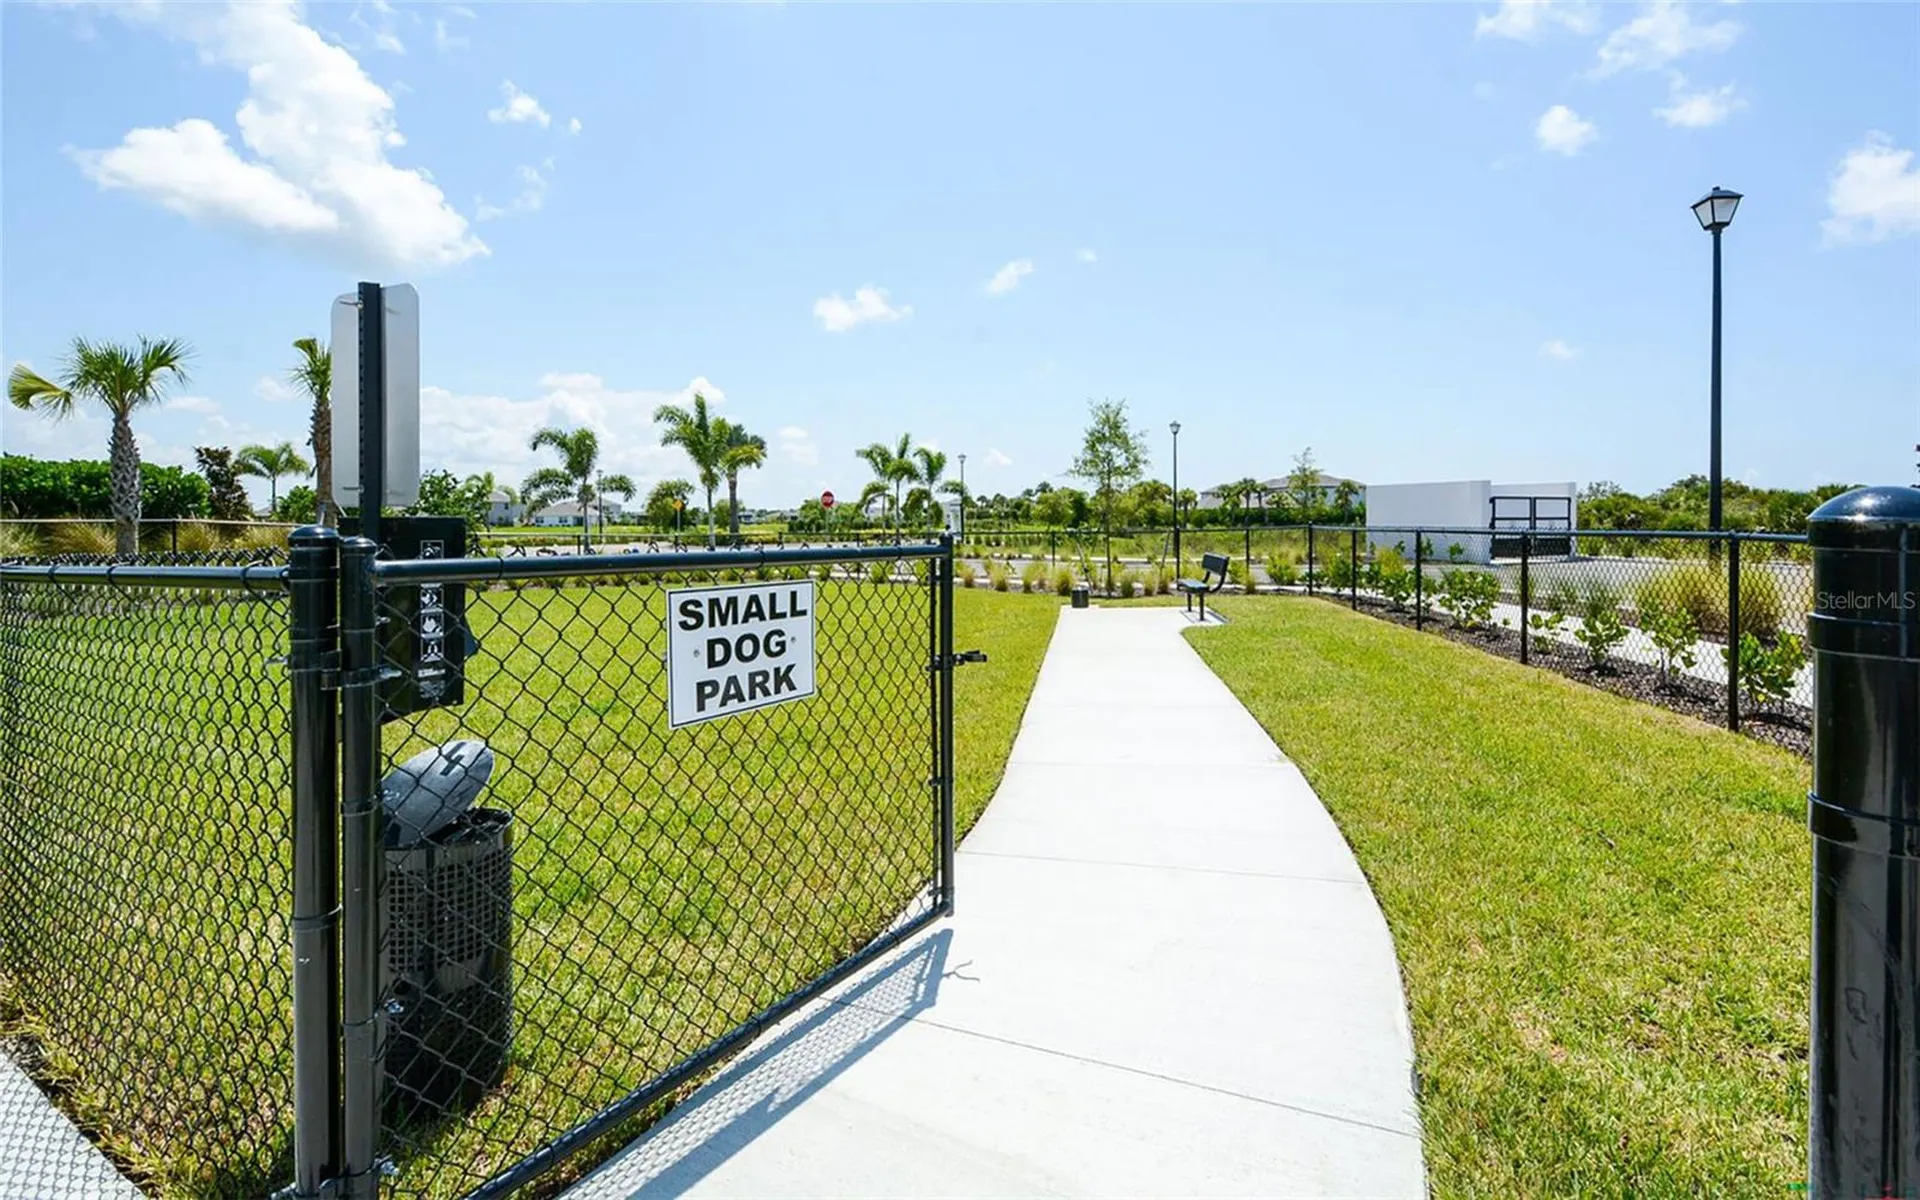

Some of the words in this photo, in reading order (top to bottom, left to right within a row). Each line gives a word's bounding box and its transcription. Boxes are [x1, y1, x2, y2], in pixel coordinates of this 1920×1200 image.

[678, 590, 808, 631] SMALL
[706, 629, 787, 669] DOG
[696, 663, 797, 713] PARK
